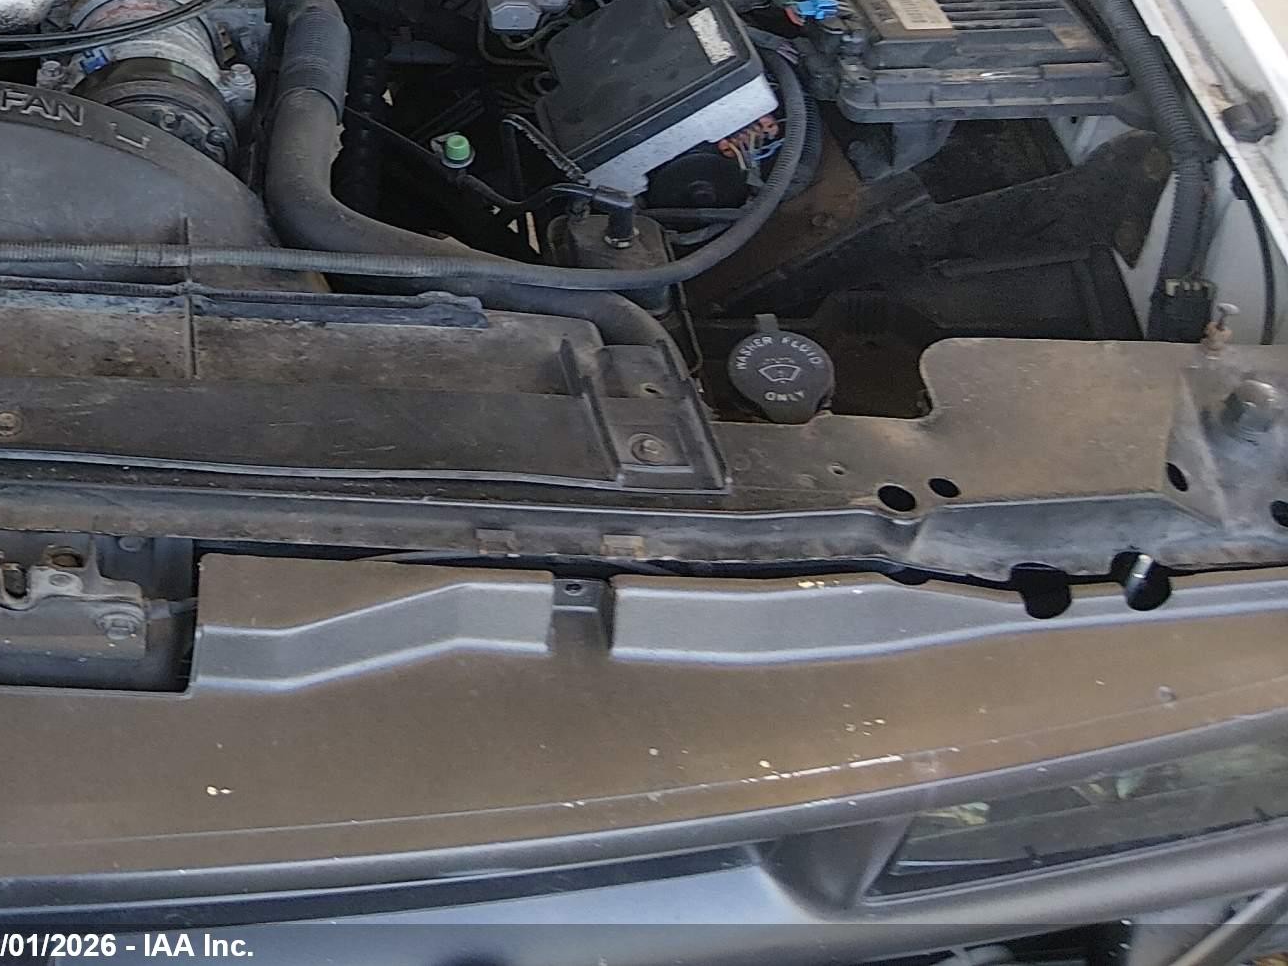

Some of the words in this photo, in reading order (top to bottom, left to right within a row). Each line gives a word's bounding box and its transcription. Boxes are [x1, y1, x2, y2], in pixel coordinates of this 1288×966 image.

[736, 336, 773, 370] WASHER
[781, 336, 824, 364] FLUID
[764, 390, 805, 402] ONLY
